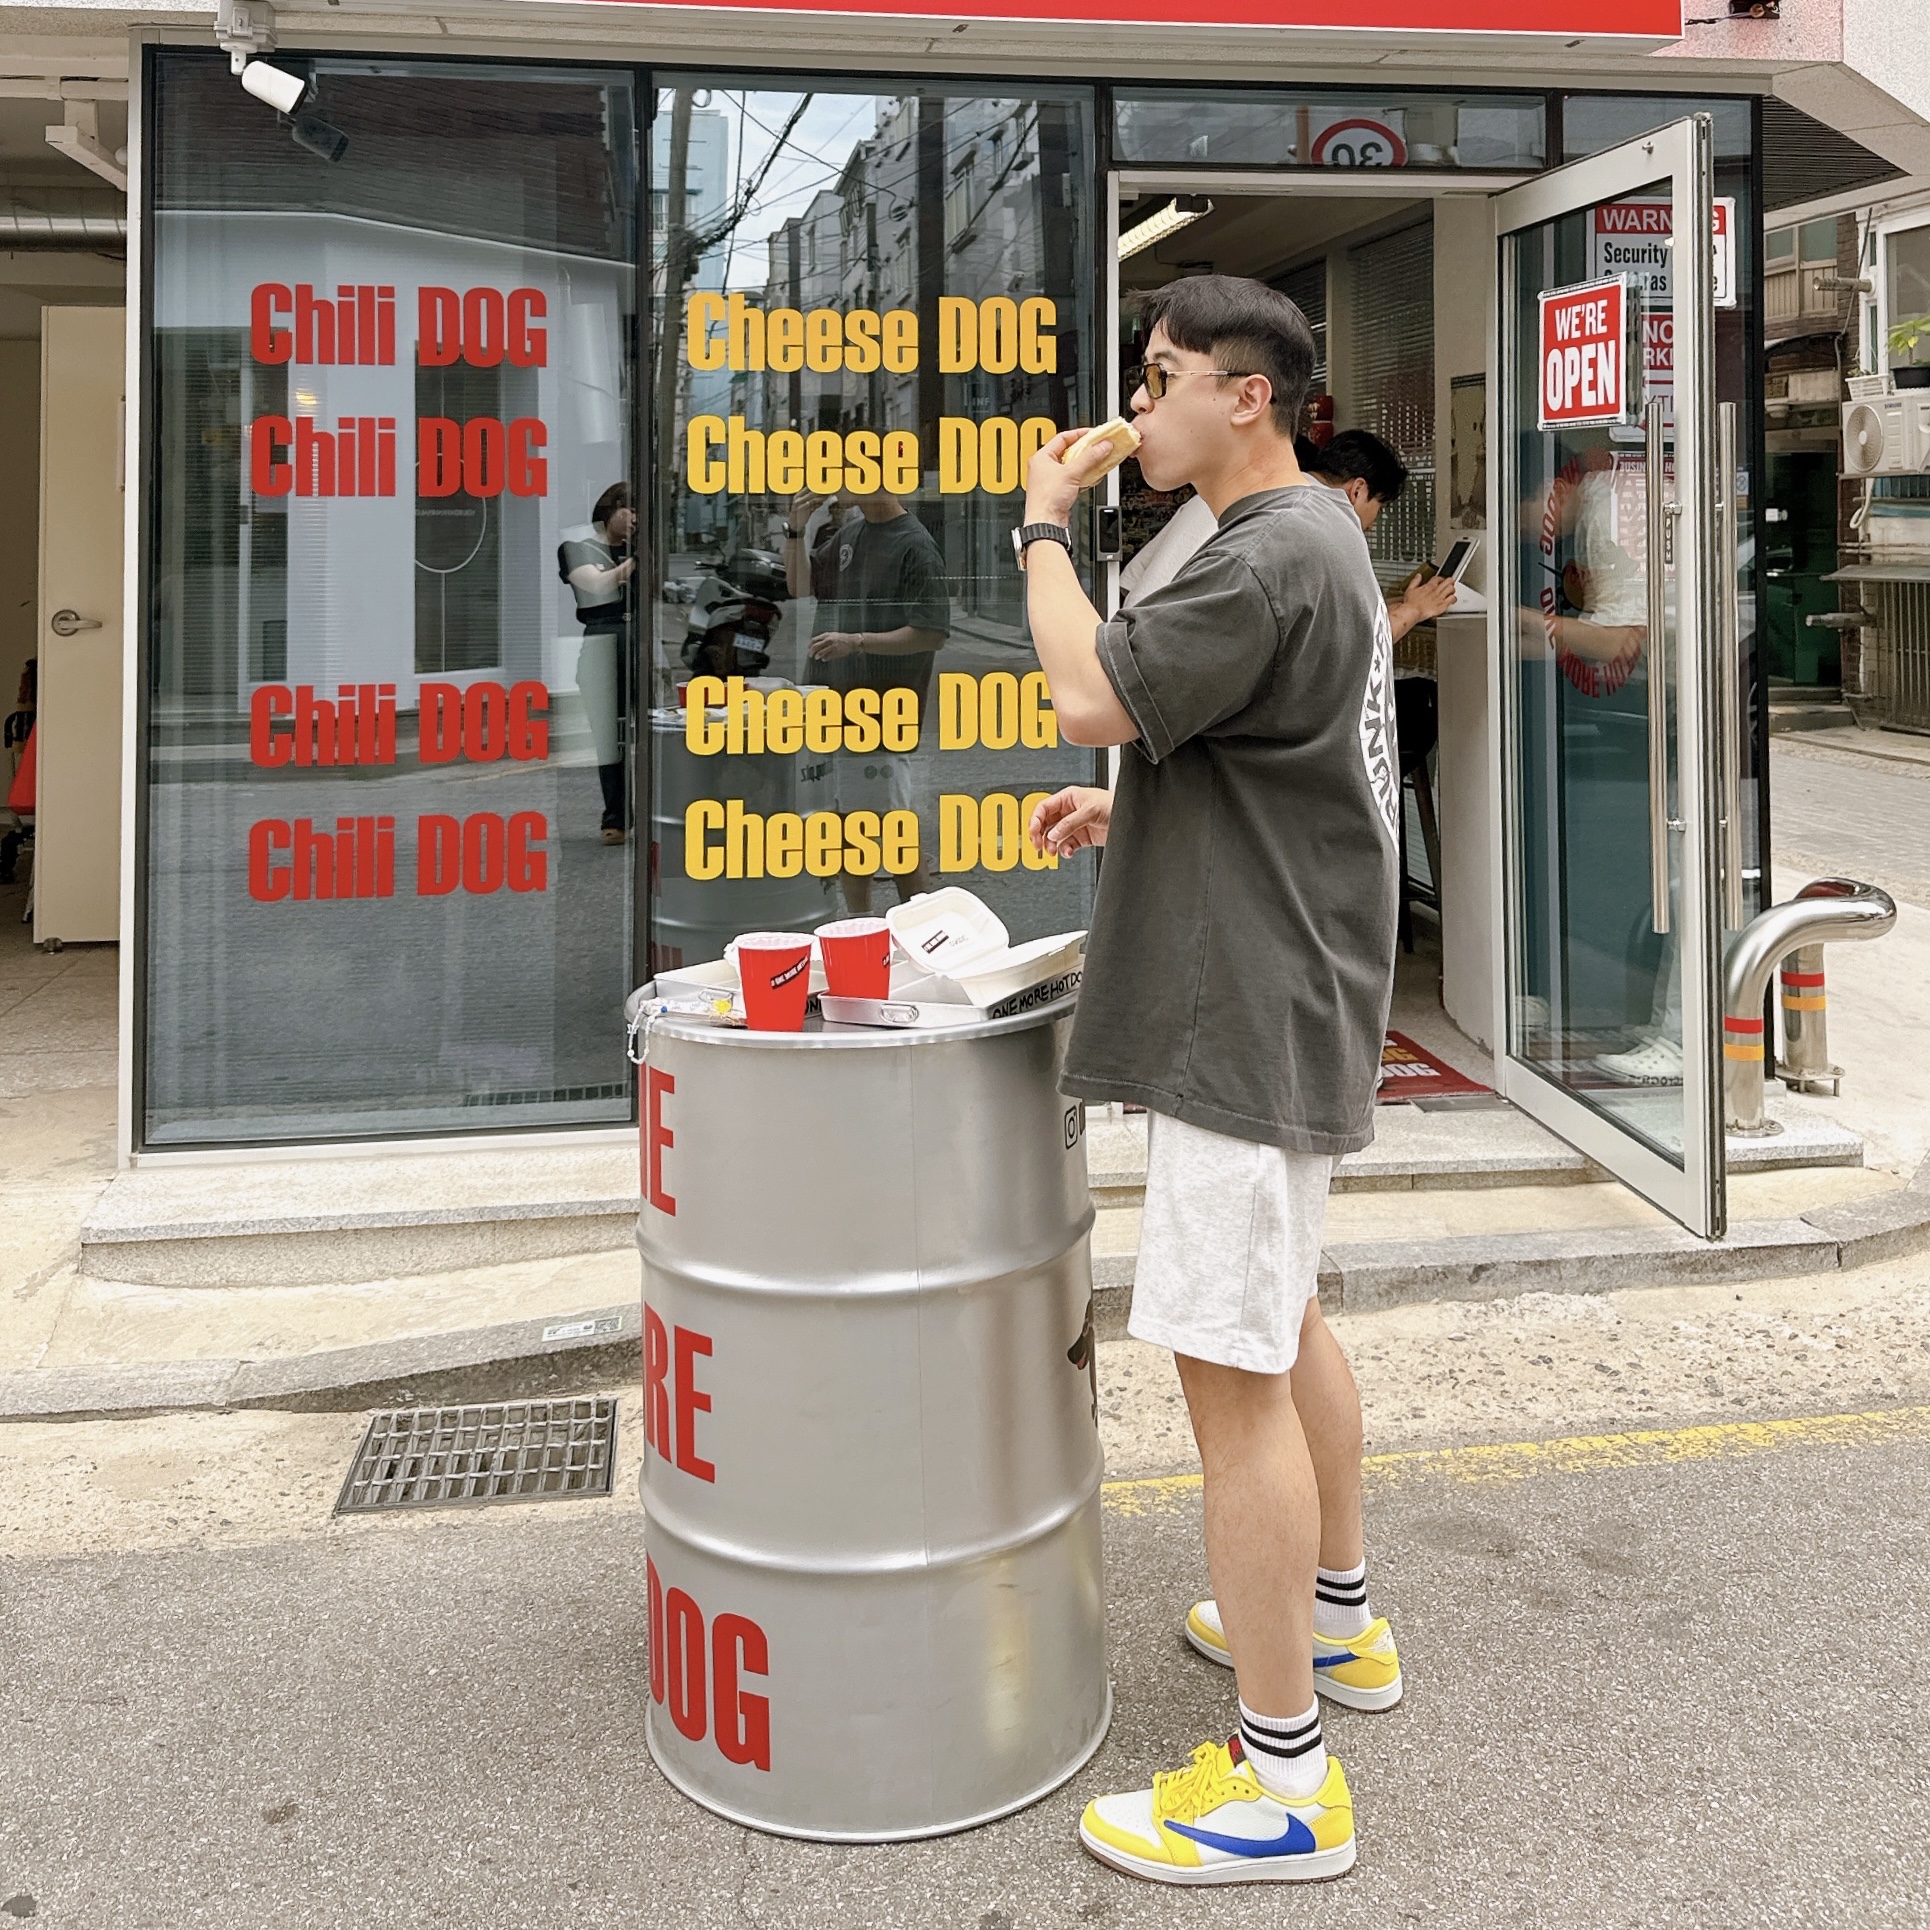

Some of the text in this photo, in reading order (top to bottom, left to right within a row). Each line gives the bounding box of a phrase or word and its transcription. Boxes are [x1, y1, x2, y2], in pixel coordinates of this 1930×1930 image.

[1604, 241, 1669, 268] Security
[251, 283, 547, 368] Chili DOG
[687, 292, 1057, 374] Cheese DOG
[1554, 299, 1608, 342] WE'RE
[1546, 339, 1616, 412] OPEN
[251, 414, 547, 498] Chili DOG
[687, 414, 919, 495] Cheese
[249, 681, 549, 768] Chili DOG
[685, 670, 1059, 755] Cheese DOG
[248, 811, 547, 902] Chili DOG
[685, 799, 920, 879] Cheese
[1019, 984, 1050, 1013] MORE
[1050, 971, 1083, 999] HOTDO
